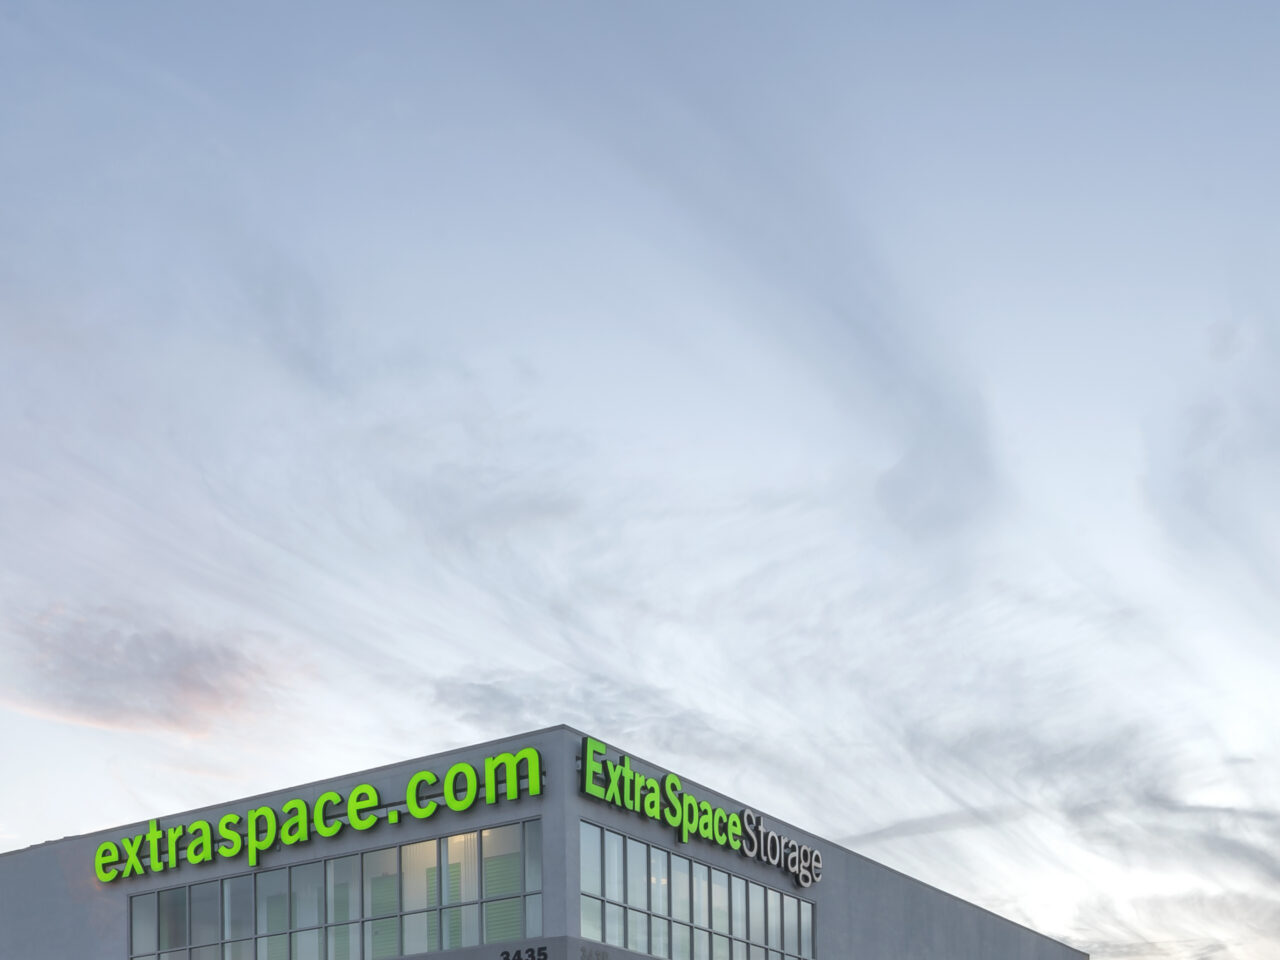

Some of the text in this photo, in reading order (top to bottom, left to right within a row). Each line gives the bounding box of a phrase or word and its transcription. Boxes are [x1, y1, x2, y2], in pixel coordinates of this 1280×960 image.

[94, 746, 542, 884] extraspace.com
[584, 736, 823, 888] Extra Space Storage
